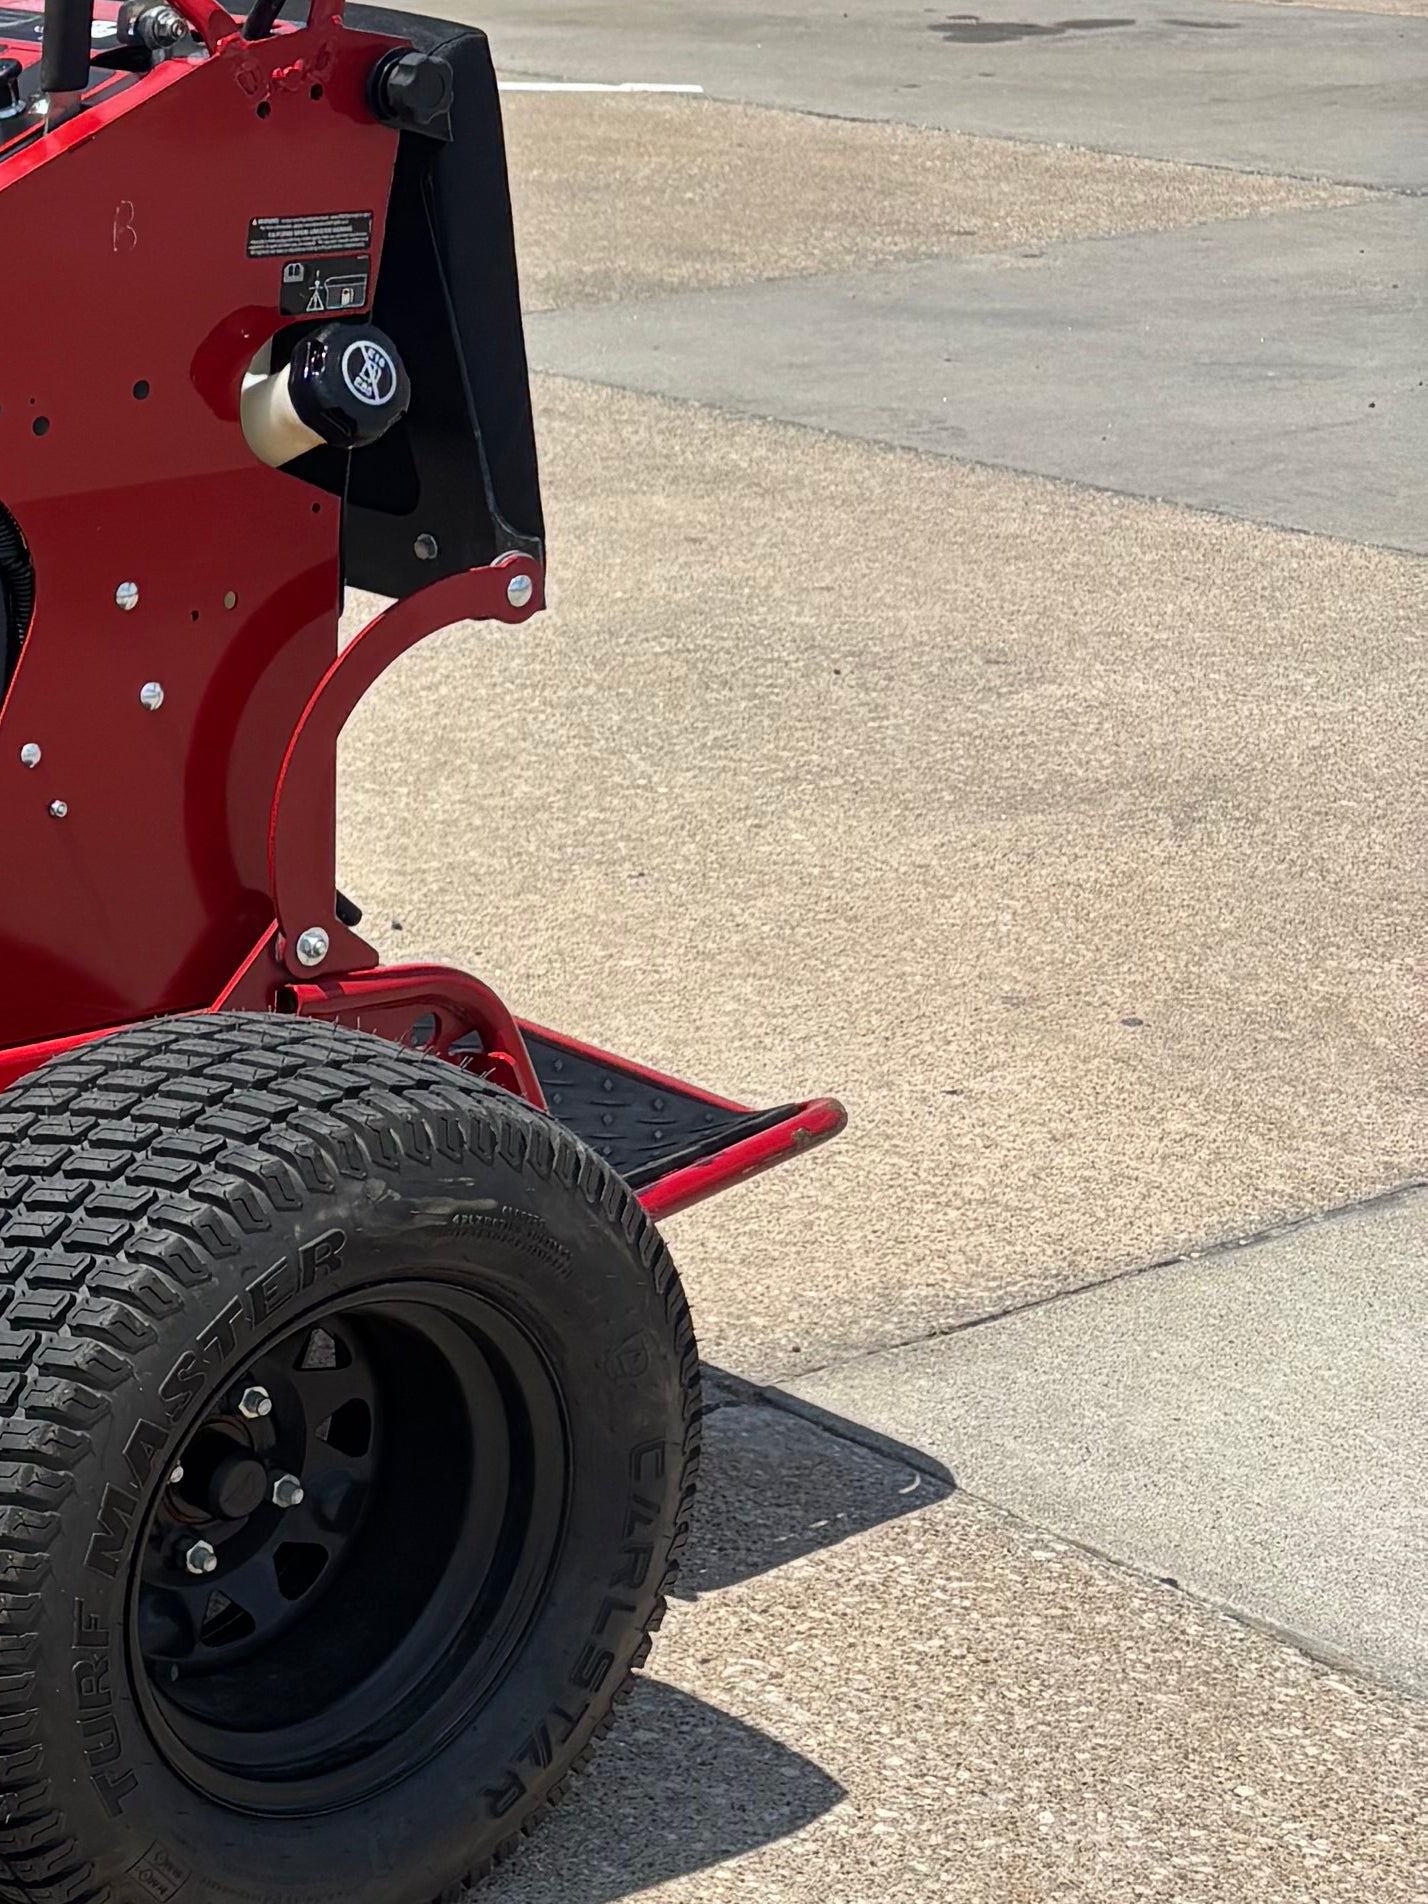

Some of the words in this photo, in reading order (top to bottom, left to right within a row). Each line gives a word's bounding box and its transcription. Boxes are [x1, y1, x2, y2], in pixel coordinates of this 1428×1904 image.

[84, 1227, 346, 1580] MASTER
[71, 1595, 141, 1820] TURF
[476, 1438, 667, 1820] CARLSTAR
